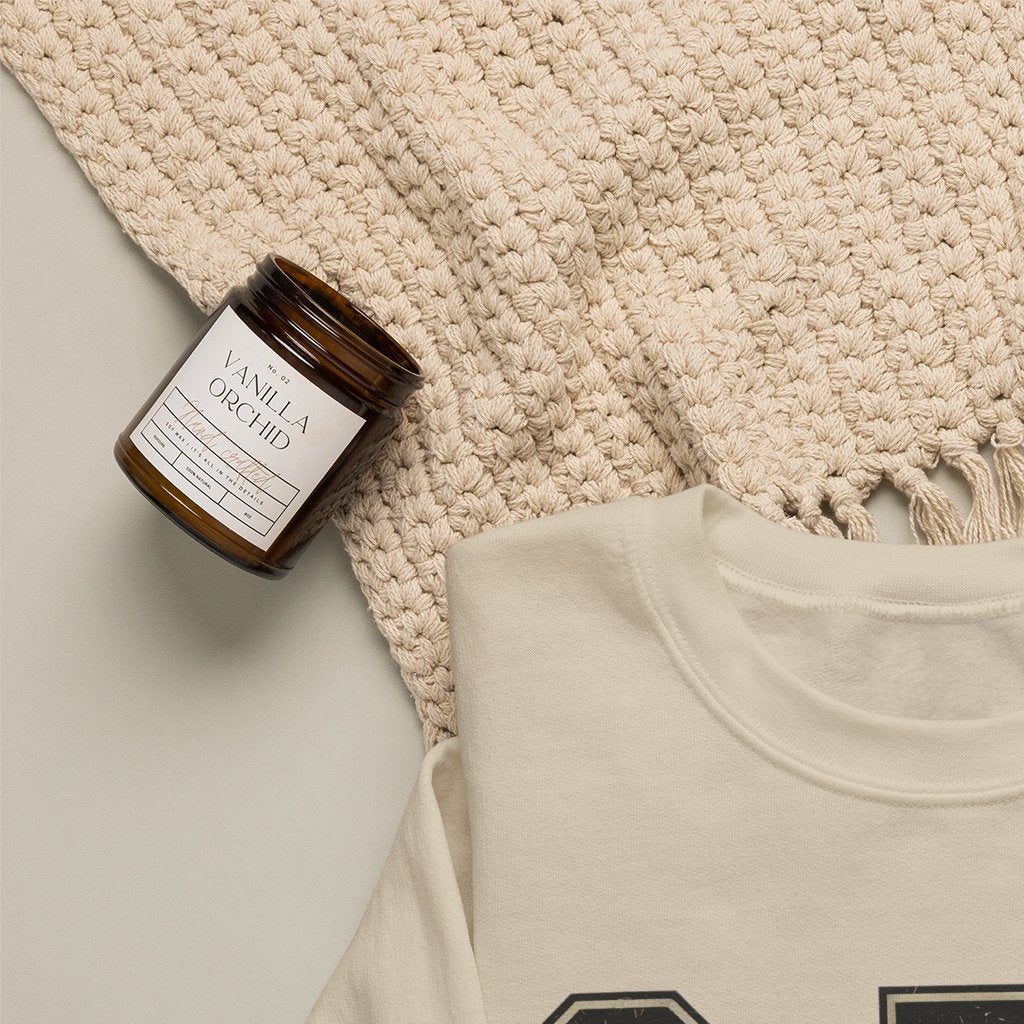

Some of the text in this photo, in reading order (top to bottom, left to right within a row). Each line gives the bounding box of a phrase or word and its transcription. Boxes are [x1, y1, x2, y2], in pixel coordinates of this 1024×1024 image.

[209, 377, 290, 450] ORCHID
[225, 349, 309, 434] VANILLA
[280, 375, 291, 385] 02
[175, 432, 185, 442] WAX
[190, 446, 202, 458] IT'S
[203, 458, 214, 468] ALL
[225, 475, 237, 486] THE
[238, 486, 264, 506] DETAILS
